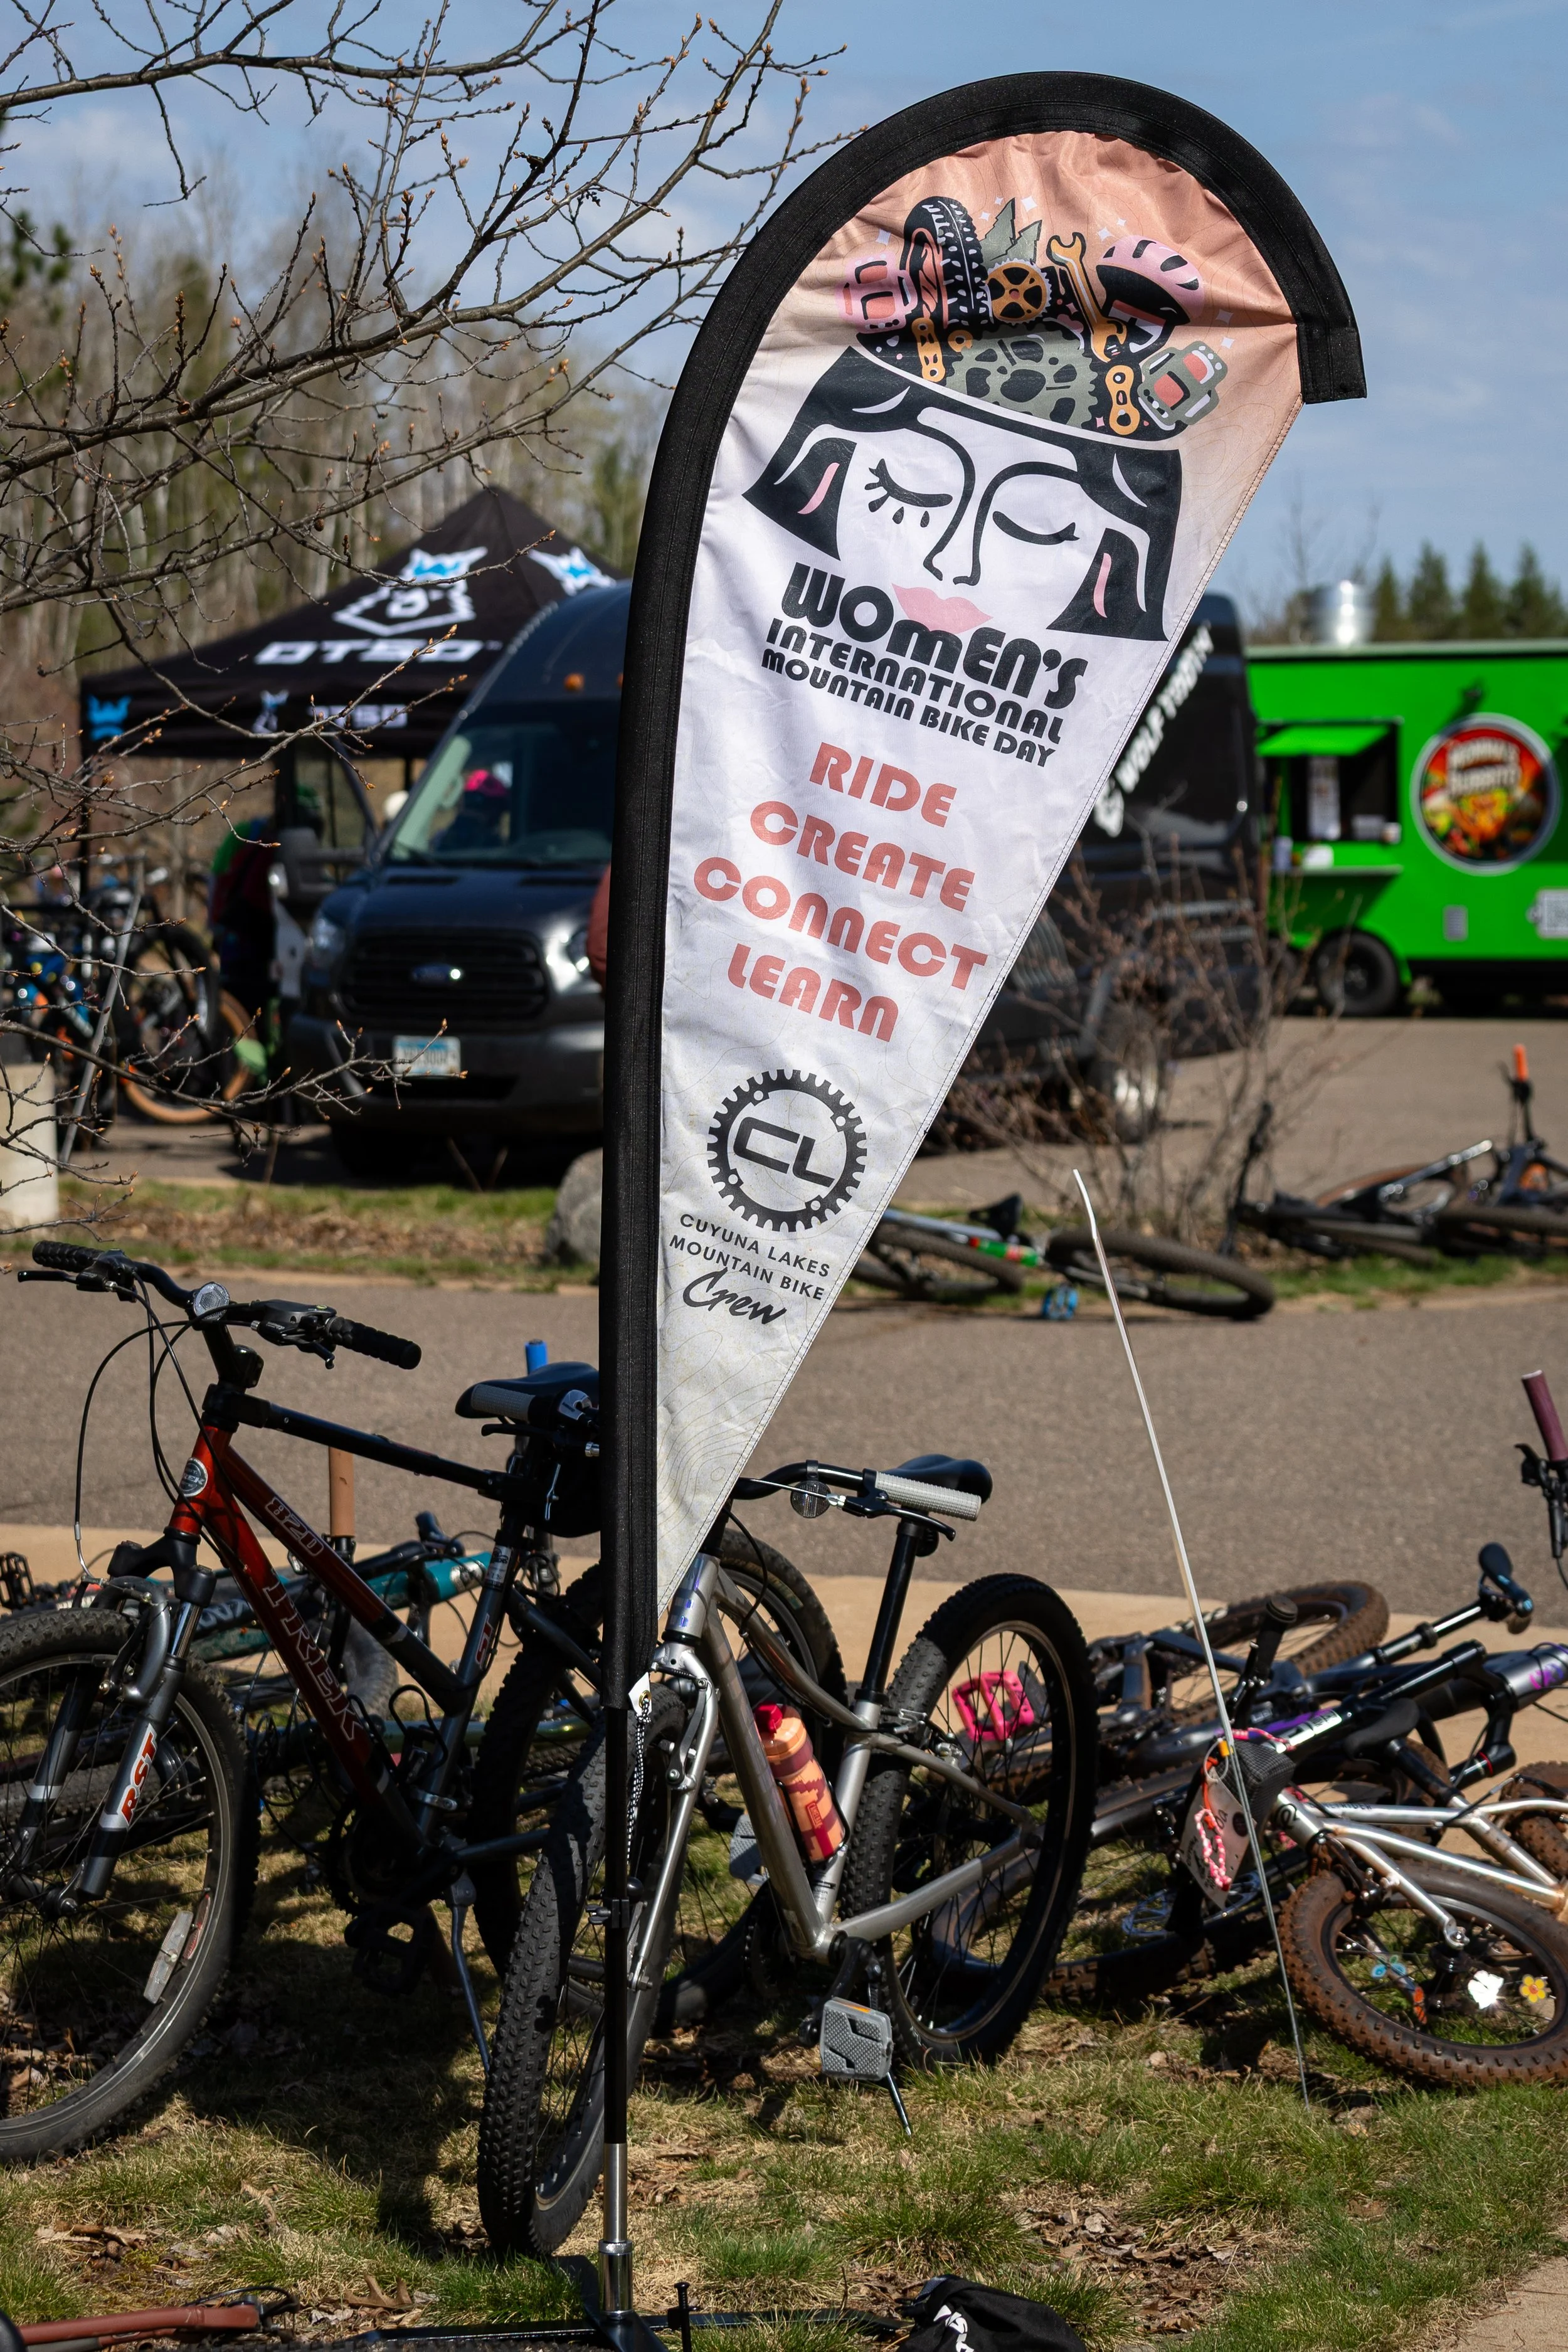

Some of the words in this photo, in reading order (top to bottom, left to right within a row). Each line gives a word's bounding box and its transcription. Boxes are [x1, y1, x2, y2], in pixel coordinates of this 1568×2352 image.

[766, 618, 1064, 744] INTERNATIONAL
[781, 562, 1088, 709] WOMEN'S
[761, 649, 914, 721] MOUNTAIN
[919, 705, 990, 746] BIKE
[993, 731, 1056, 767] DAY
[810, 743, 956, 827] RIDE
[750, 801, 975, 911] CREATE
[694, 857, 987, 990] CONNECT
[728, 944, 899, 1041] LEARN
[733, 1116, 835, 1188] CL
[669, 1234, 773, 1284] MOUNTAIN
[780, 1275, 824, 1300] BIKE
[680, 1214, 759, 1254] CUYUNA
[768, 1246, 830, 1277] LAKES
[682, 1266, 787, 1325] Crew
[265, 1496, 325, 1557] 820
[262, 1568, 364, 1742] TREK
[119, 1726, 157, 1827] RST
